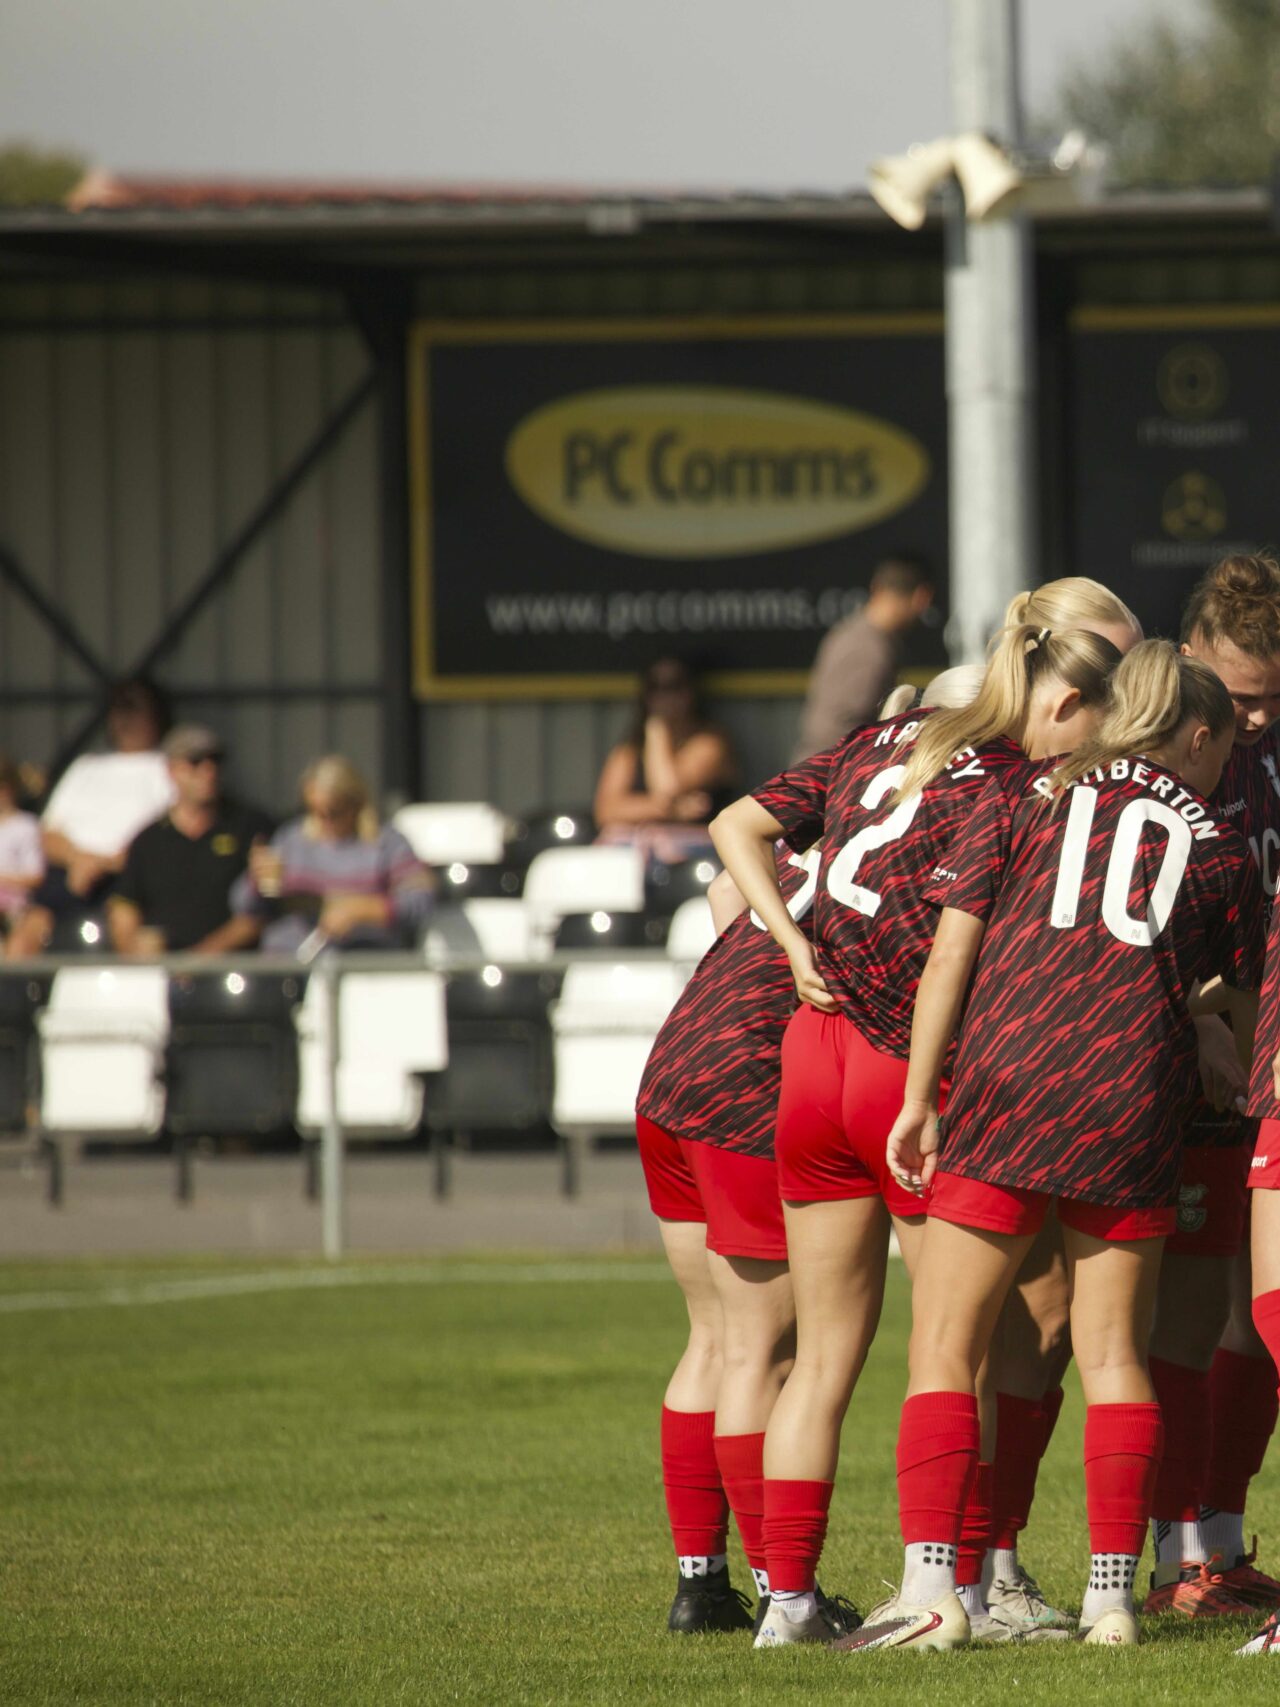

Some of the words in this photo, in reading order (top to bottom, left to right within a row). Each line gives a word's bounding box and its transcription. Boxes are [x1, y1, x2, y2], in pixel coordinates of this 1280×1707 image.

[563, 431, 635, 506] PC
[648, 431, 879, 505] Comms
[827, 764, 923, 918] 2
[1050, 785, 1192, 947] 10
